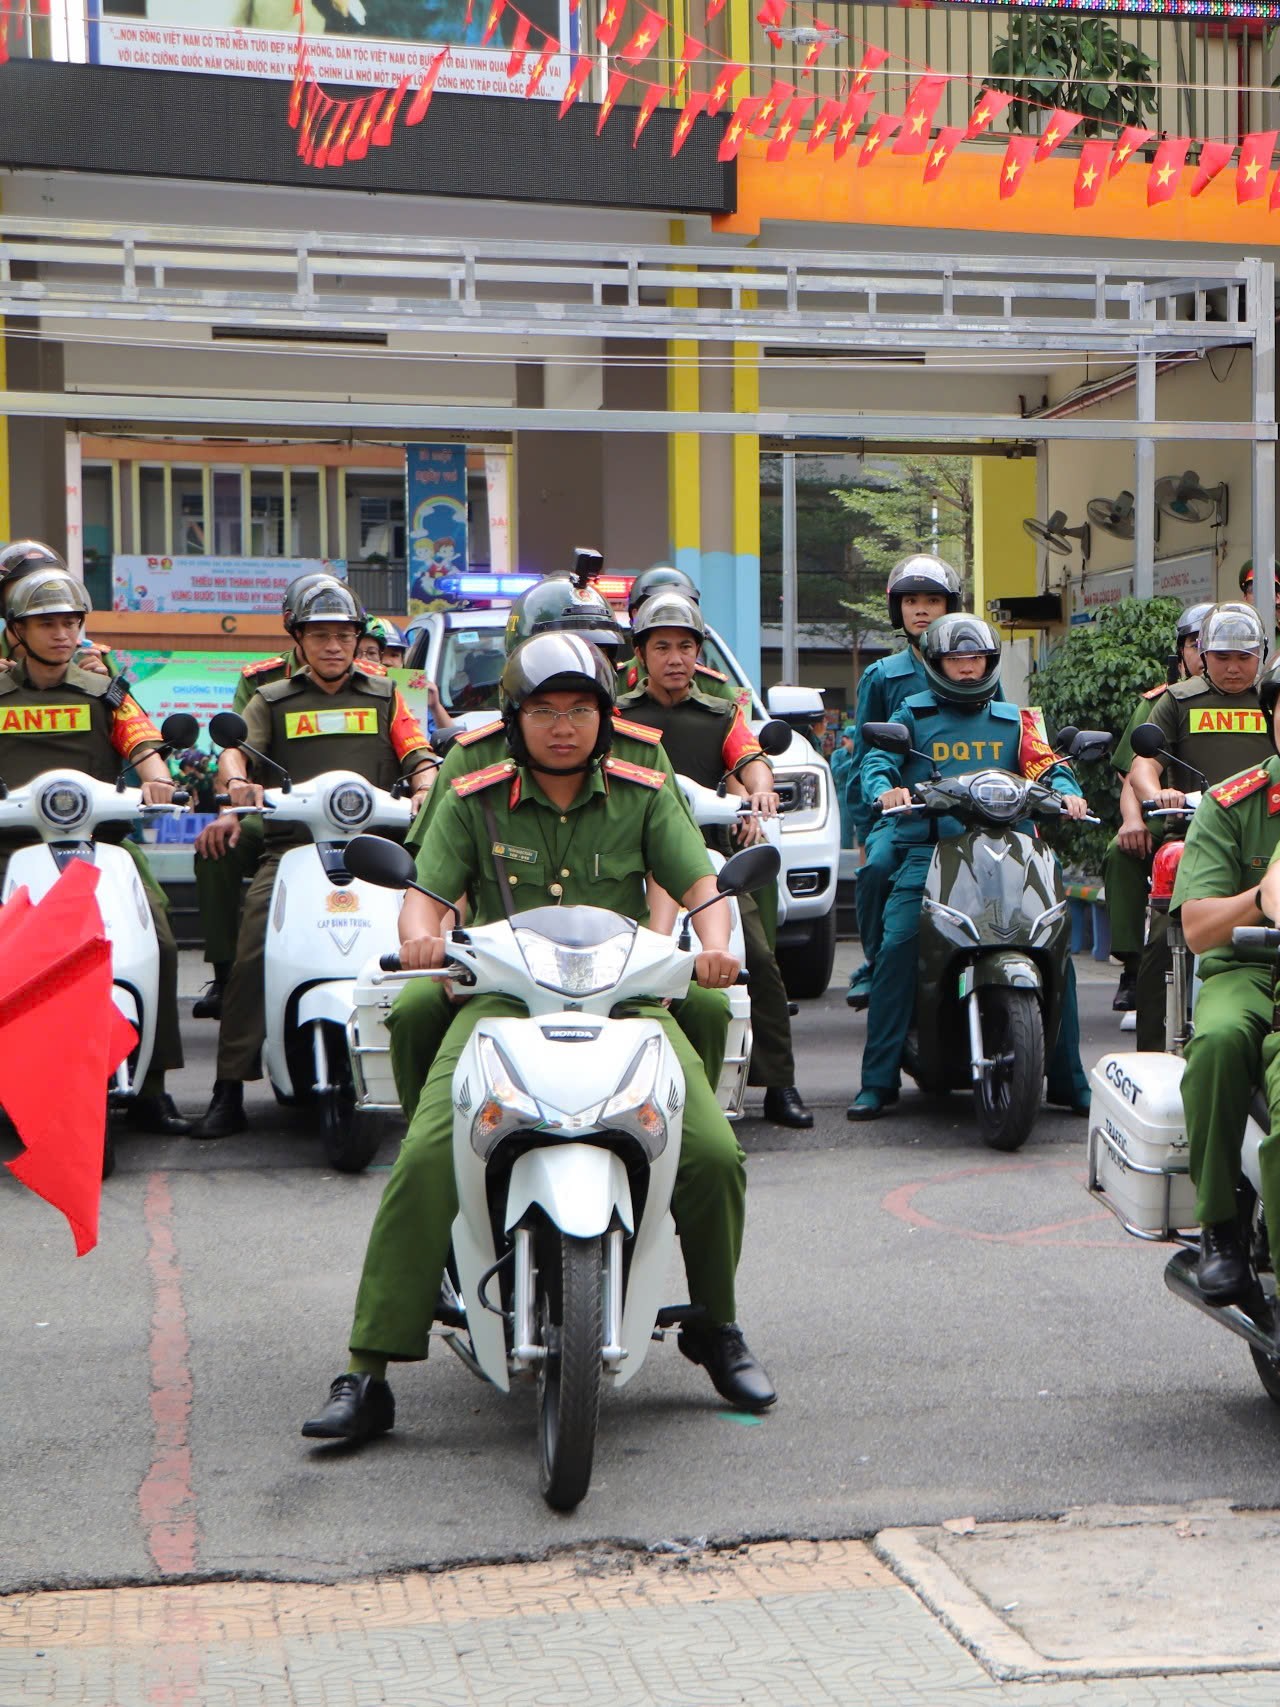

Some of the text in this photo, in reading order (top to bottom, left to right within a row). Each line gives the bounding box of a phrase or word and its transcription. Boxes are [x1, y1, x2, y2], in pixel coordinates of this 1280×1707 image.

[139, 29, 161, 44] SÔNG
[163, 30, 180, 48] VIỆT
[183, 34, 201, 46] NAM
[202, 33, 214, 47] CÓ
[371, 48, 387, 62] VIỆT
[389, 52, 405, 64] NAM
[470, 59, 487, 71] VINH
[549, 65, 562, 77] VAI
[270, 63, 285, 75] HAY
[437, 74, 458, 89] CÔNG
[2, 708, 82, 731] ANTT
[296, 711, 369, 735] AT
[1198, 711, 1264, 731] ANTT
[932, 741, 1004, 761] DQTT
[550, 1030, 594, 1038] HONDA
[1105, 1061, 1143, 1105] CSGT
